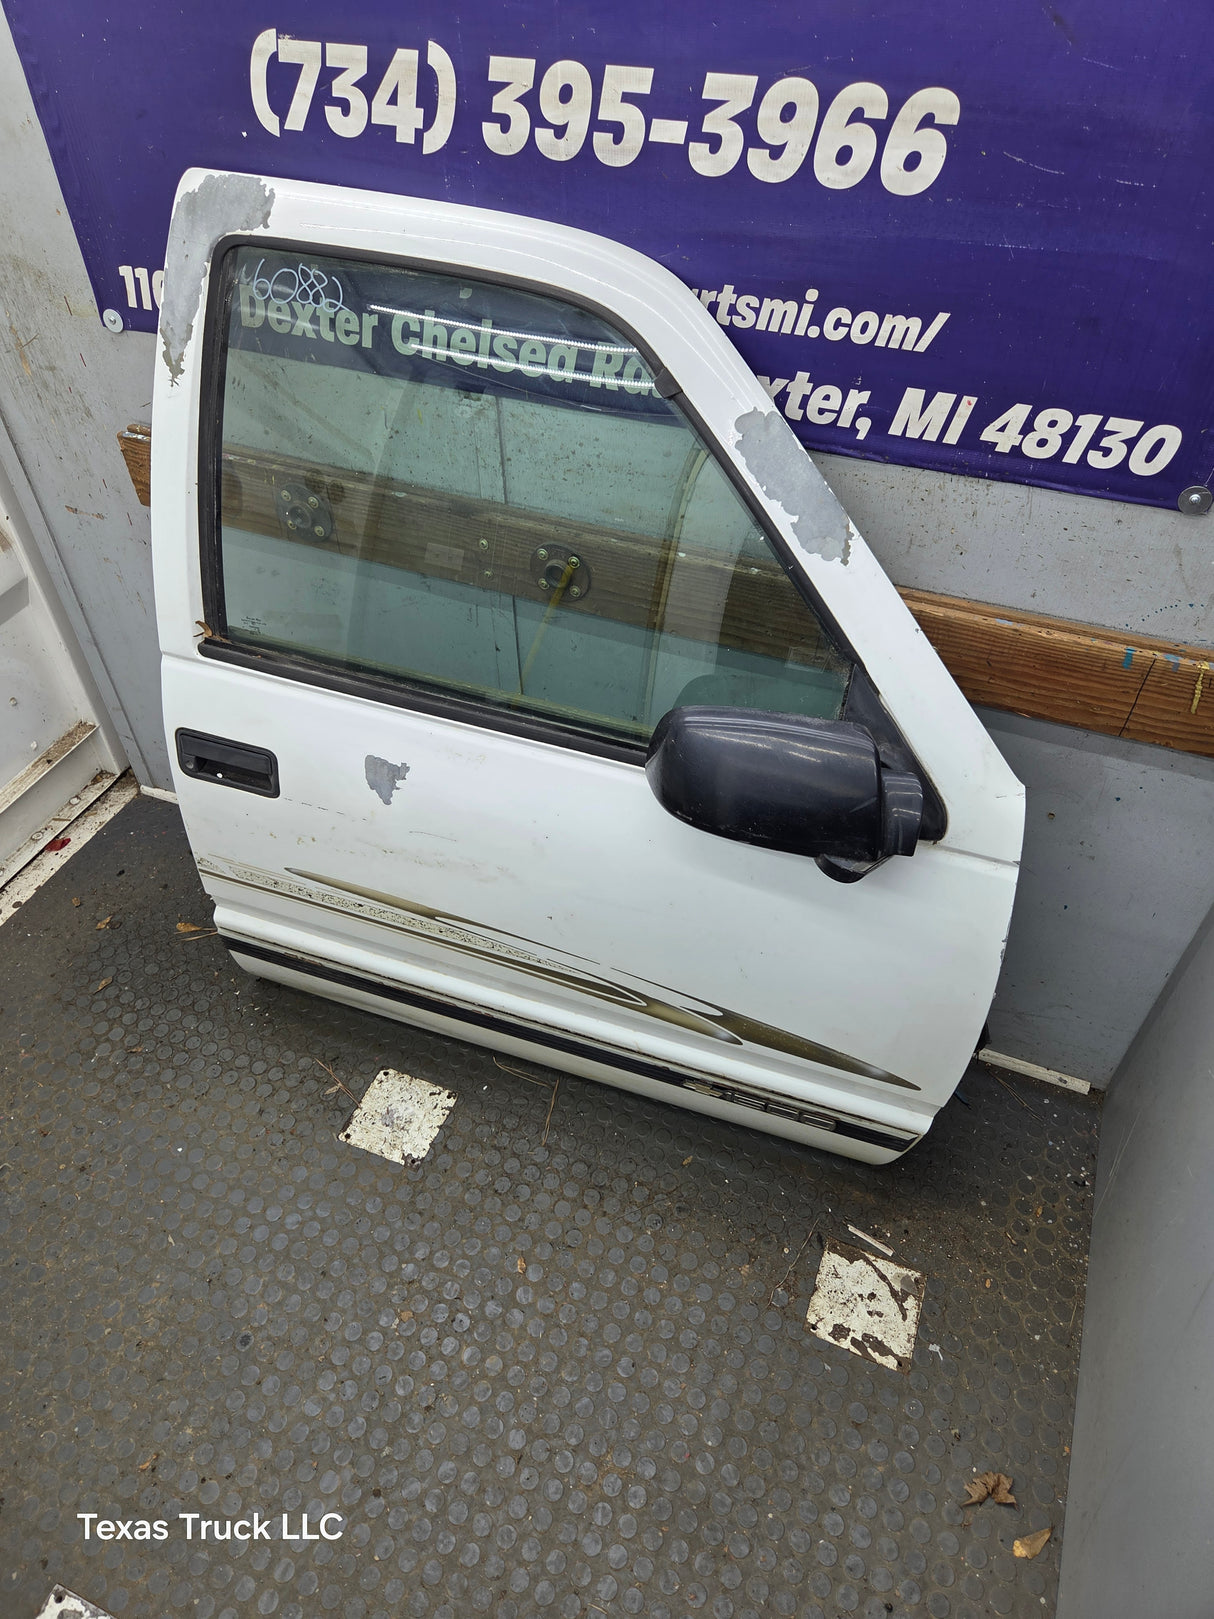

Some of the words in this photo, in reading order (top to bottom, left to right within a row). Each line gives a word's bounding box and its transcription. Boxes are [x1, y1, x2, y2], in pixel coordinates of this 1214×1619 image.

[250, 28, 456, 155] (734)
[482, 55, 960, 196] 395-3966
[239, 284, 379, 349] Dexter
[391, 309, 579, 384] Chelsea
[888, 387, 978, 446] MI
[979, 403, 1184, 477] 48130
[692, 284, 951, 353] rtsmi.com/
